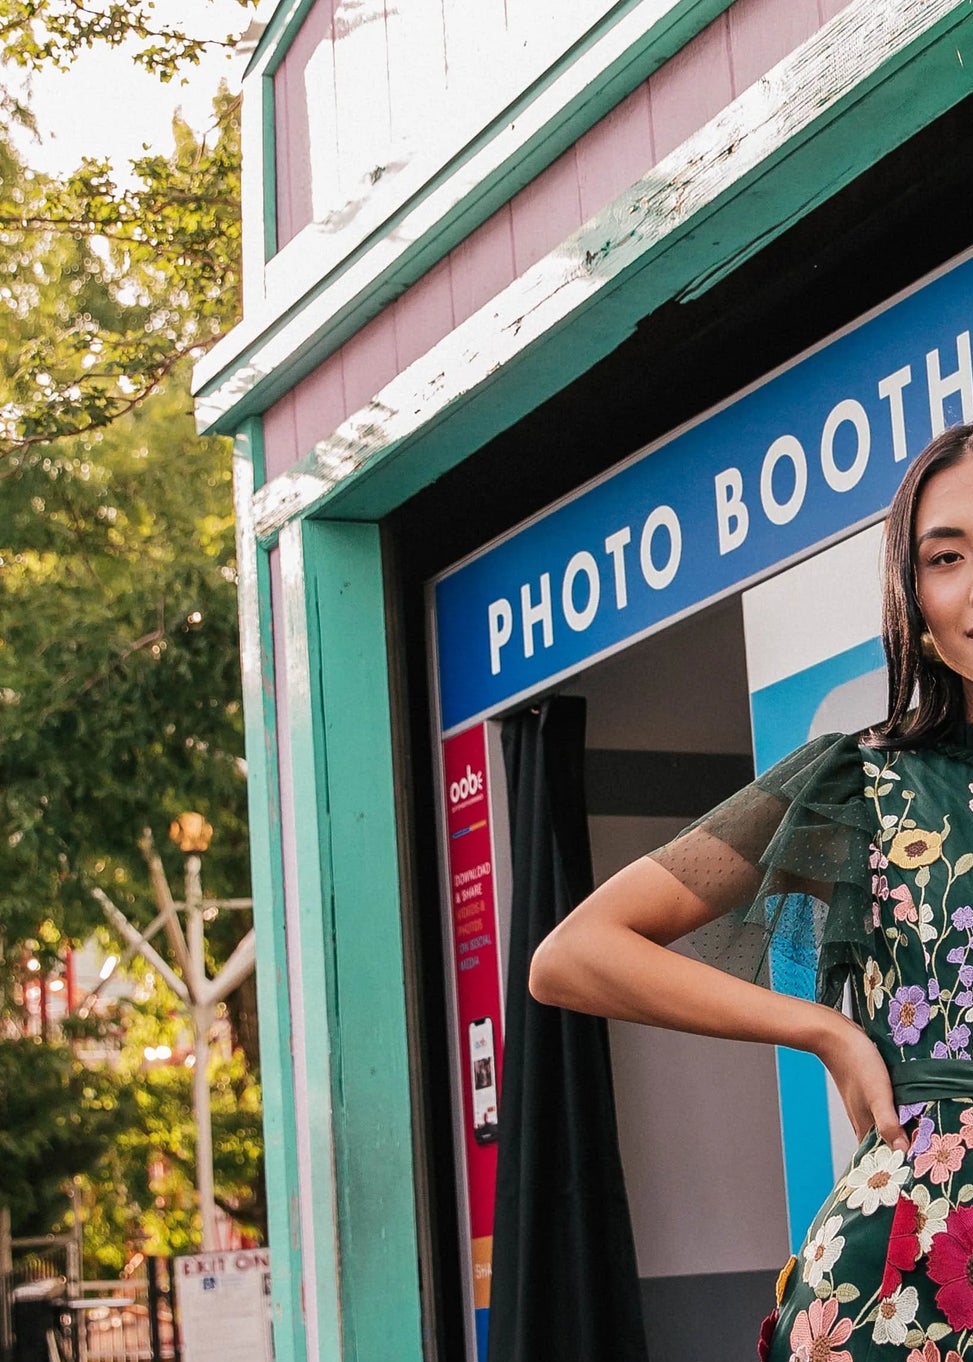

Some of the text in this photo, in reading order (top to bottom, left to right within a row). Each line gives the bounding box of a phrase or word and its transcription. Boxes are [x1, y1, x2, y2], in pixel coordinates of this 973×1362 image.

[488, 505, 682, 675] PHOTO
[454, 862, 491, 888] DOWNLOAD
[461, 883, 483, 903] SHARE
[469, 934, 491, 951] SOCIAL
[460, 955, 480, 971] MEDIA
[183, 1257, 225, 1276] EXIT
